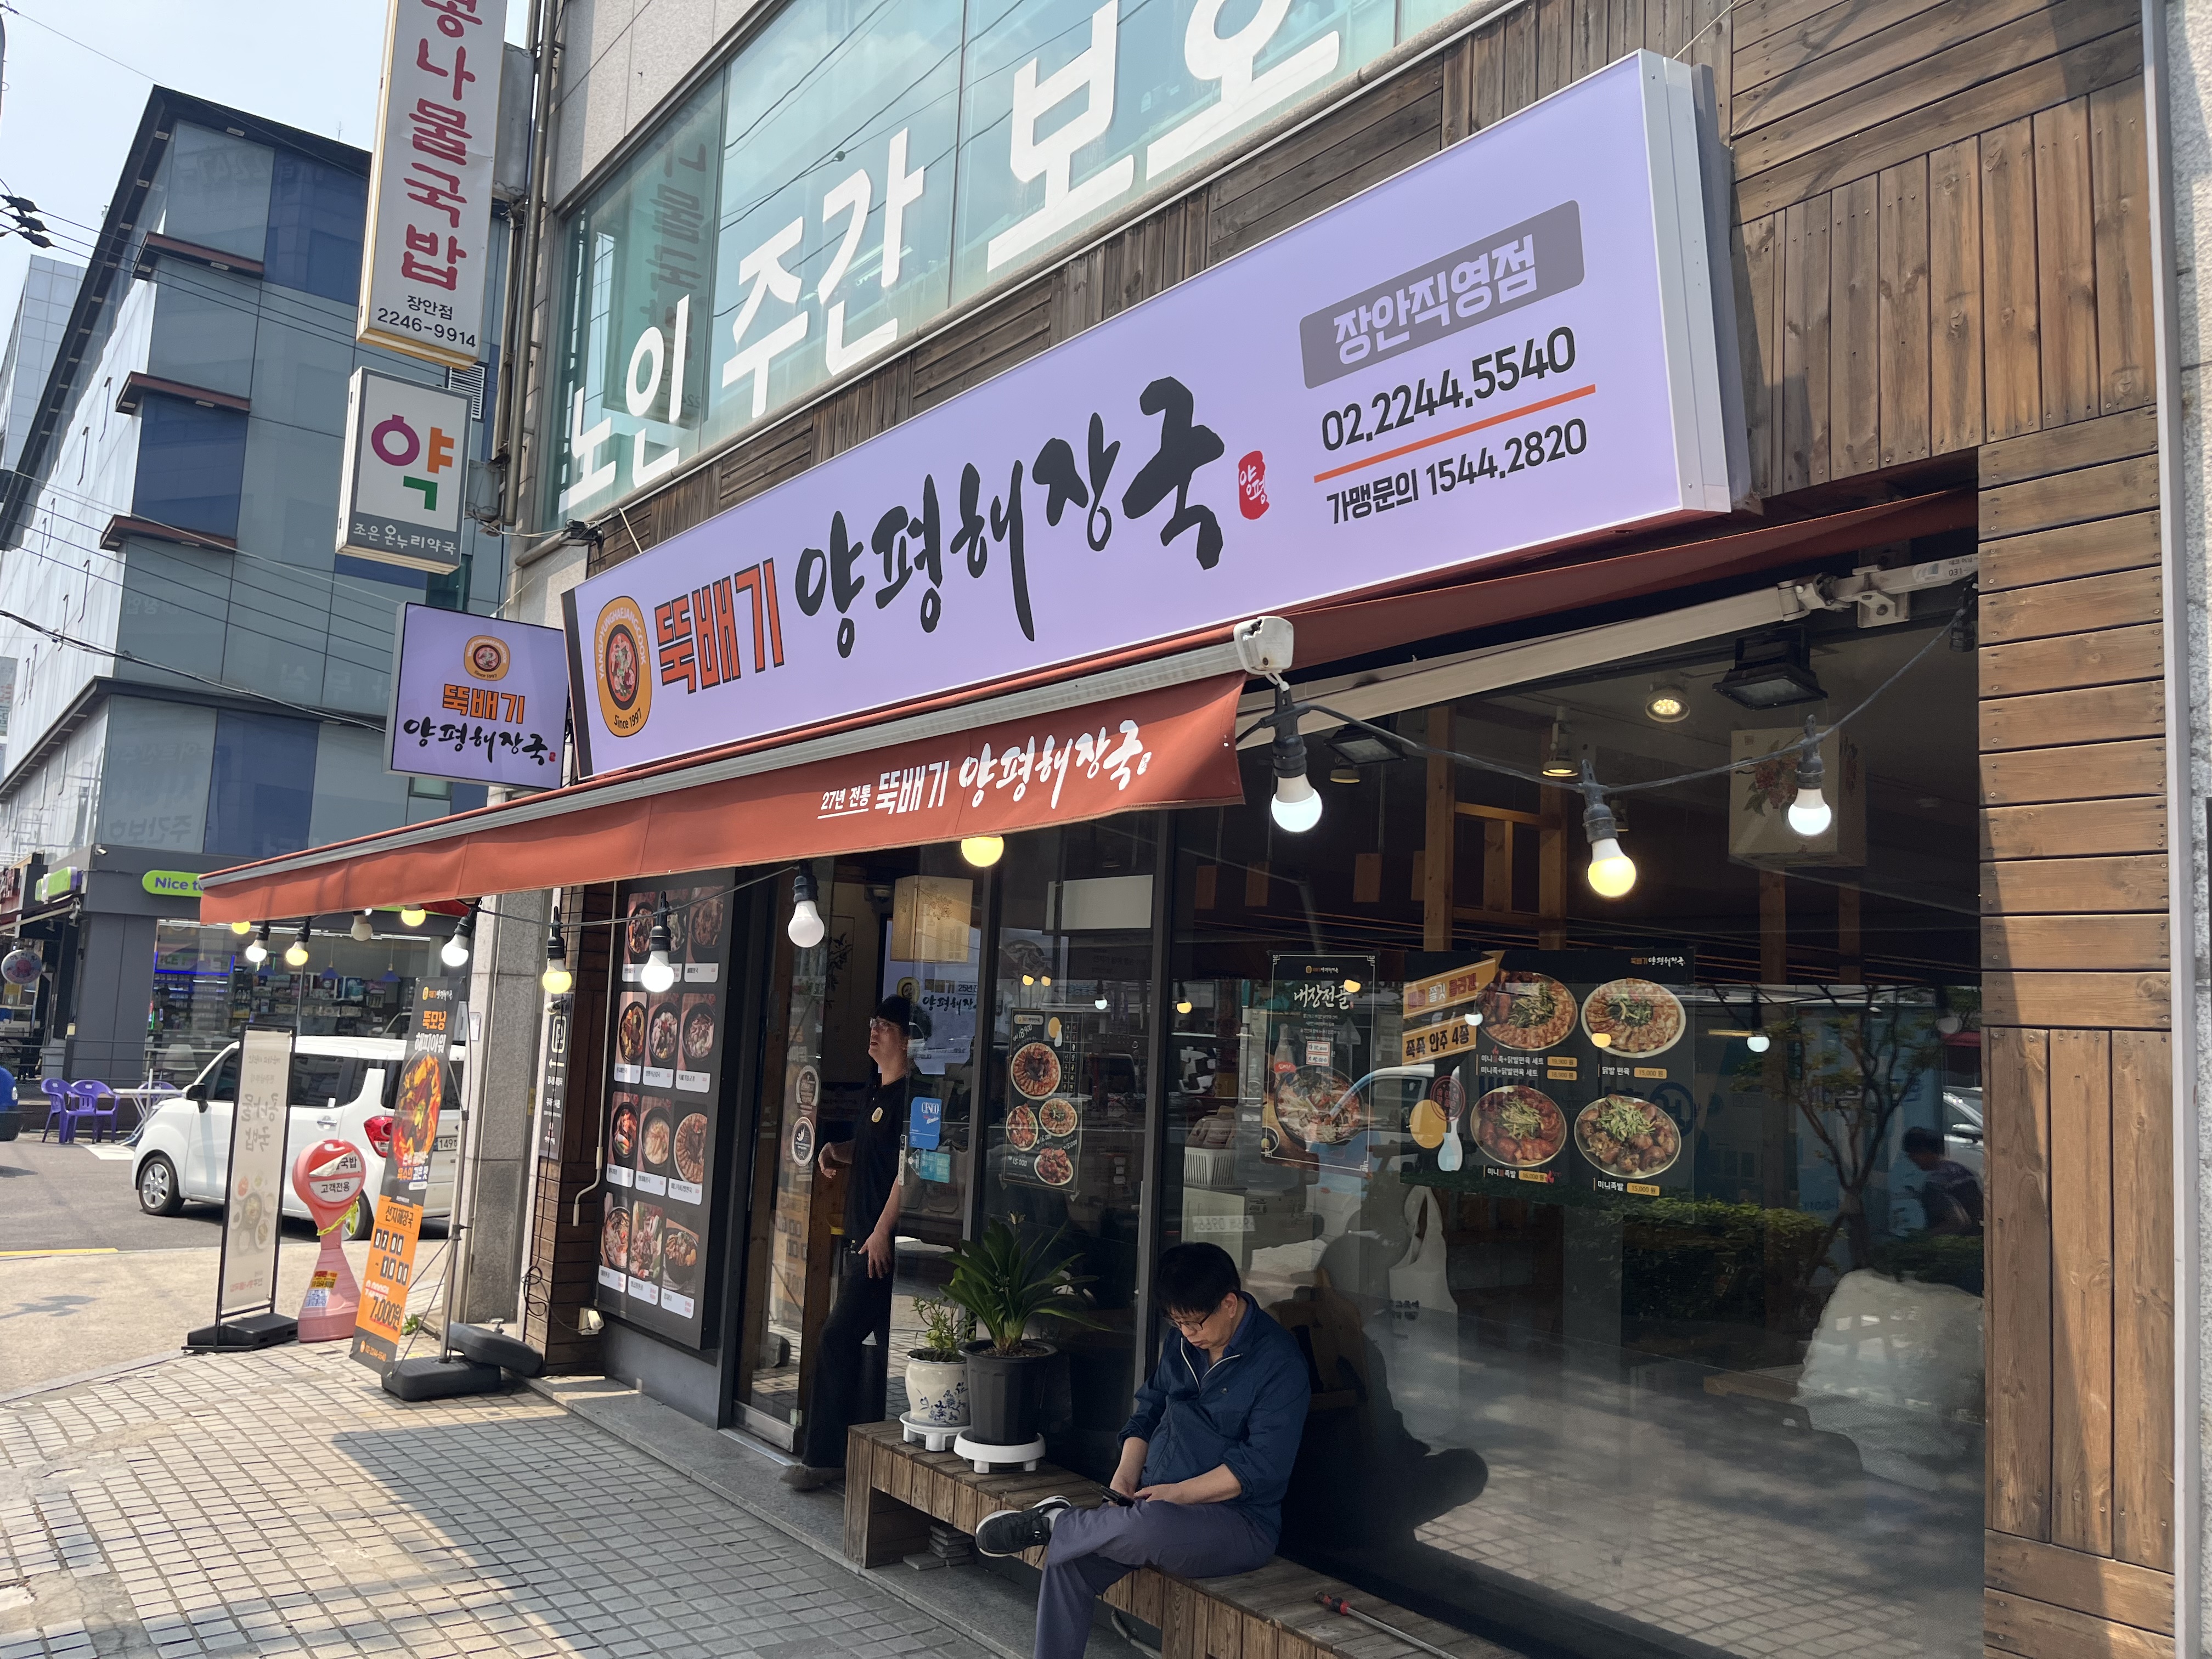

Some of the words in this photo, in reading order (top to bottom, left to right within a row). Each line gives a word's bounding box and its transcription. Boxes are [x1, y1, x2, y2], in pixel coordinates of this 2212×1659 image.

[407, 295, 453, 320] 장안점
[1334, 234, 1537, 364] 장안직영점
[377, 308, 477, 348] 2246-9914
[558, 294, 689, 514] 노인
[722, 127, 925, 419] 주간
[1322, 326, 1576, 451] 02.2244.5540
[371, 414, 454, 511] 약
[1326, 469, 1419, 524] 가맹문의
[1426, 418, 1587, 495] 1544.2820
[352, 523, 380, 540] 조은
[384, 524, 457, 556] 온누리약국
[654, 557, 784, 694] 뚝배기
[795, 376, 1225, 658] 양평해장국
[598, 607, 646, 680] YANGPYUNGHAEJANGCOOK
[442, 684, 525, 724] 뚝배기
[614, 714, 629, 729] Since
[629, 707, 642, 727] 1997
[403, 716, 548, 765] 양평해장국
[820, 788, 845, 811] 27년
[848, 783, 871, 806] 전통
[874, 759, 950, 815] 뚝배기
[958, 719, 1143, 809] 양평해장국
[155, 877, 188, 890] Nice
[922, 995, 977, 1016] 양평해장
[1294, 984, 1352, 1010] 내장전골
[414, 1032, 447, 1054] 해피아워
[1429, 1029, 1448, 1053] 안주
[1452, 1024, 1470, 1045] 4종
[1526, 1069, 1539, 1077] 세트
[1532, 1057, 1544, 1065] 세트
[1602, 1066, 1615, 1075] 닭발
[1616, 1066, 1630, 1076] 편육
[1657, 1070, 1663, 1078] 원
[320, 1182, 350, 1194] 고객전용
[1598, 1181, 1624, 1192] 미니족발
[1631, 1185, 1649, 1193] 15,000
[386, 1206, 414, 1229] 선지해장국
